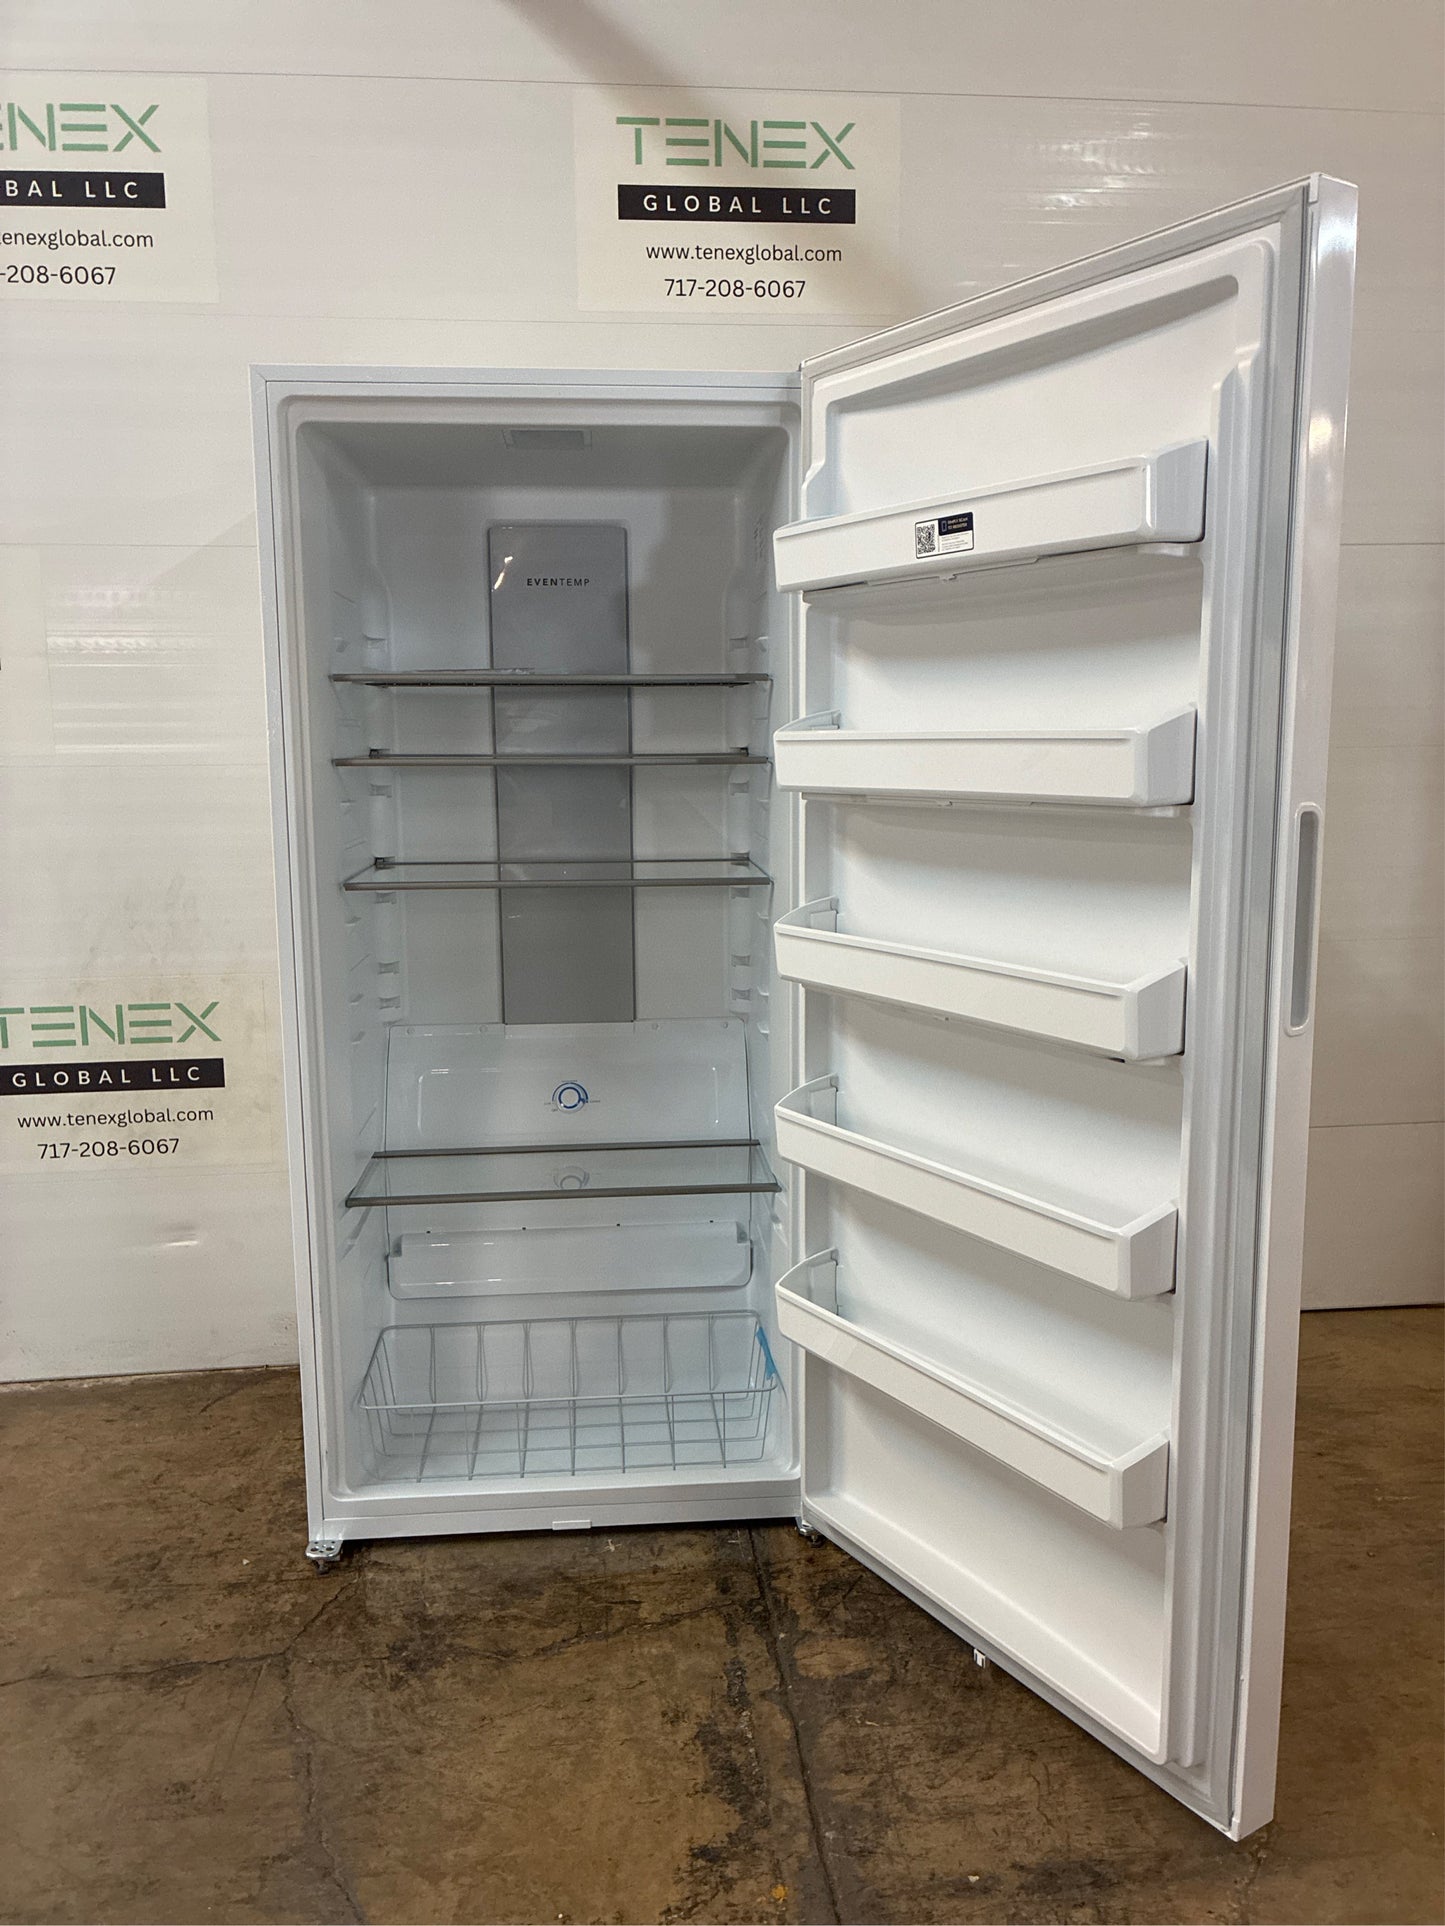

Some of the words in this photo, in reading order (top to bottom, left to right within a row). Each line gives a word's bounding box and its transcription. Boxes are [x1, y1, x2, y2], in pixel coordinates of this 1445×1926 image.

[0, 102, 162, 152] NEX
[616, 116, 856, 169] TENEX
[3, 179, 63, 199] BAL
[85, 181, 139, 200] LLC
[643, 194, 762, 214] GLOBAL
[782, 197, 832, 215] LLC
[646, 244, 842, 265] www.tenexglobal.com
[0, 264, 116, 285] -208-6067
[664, 278, 806, 298] 717-208-6067
[526, 578, 590, 587] EVENTEMP
[0, 1001, 222, 1048] TENEX
[12, 1069, 131, 1087] GLOBAL
[151, 1066, 200, 1083] LLC
[17, 1108, 214, 1128] www.tenexglobal.com
[37, 1138, 180, 1160] 717-208-6067
